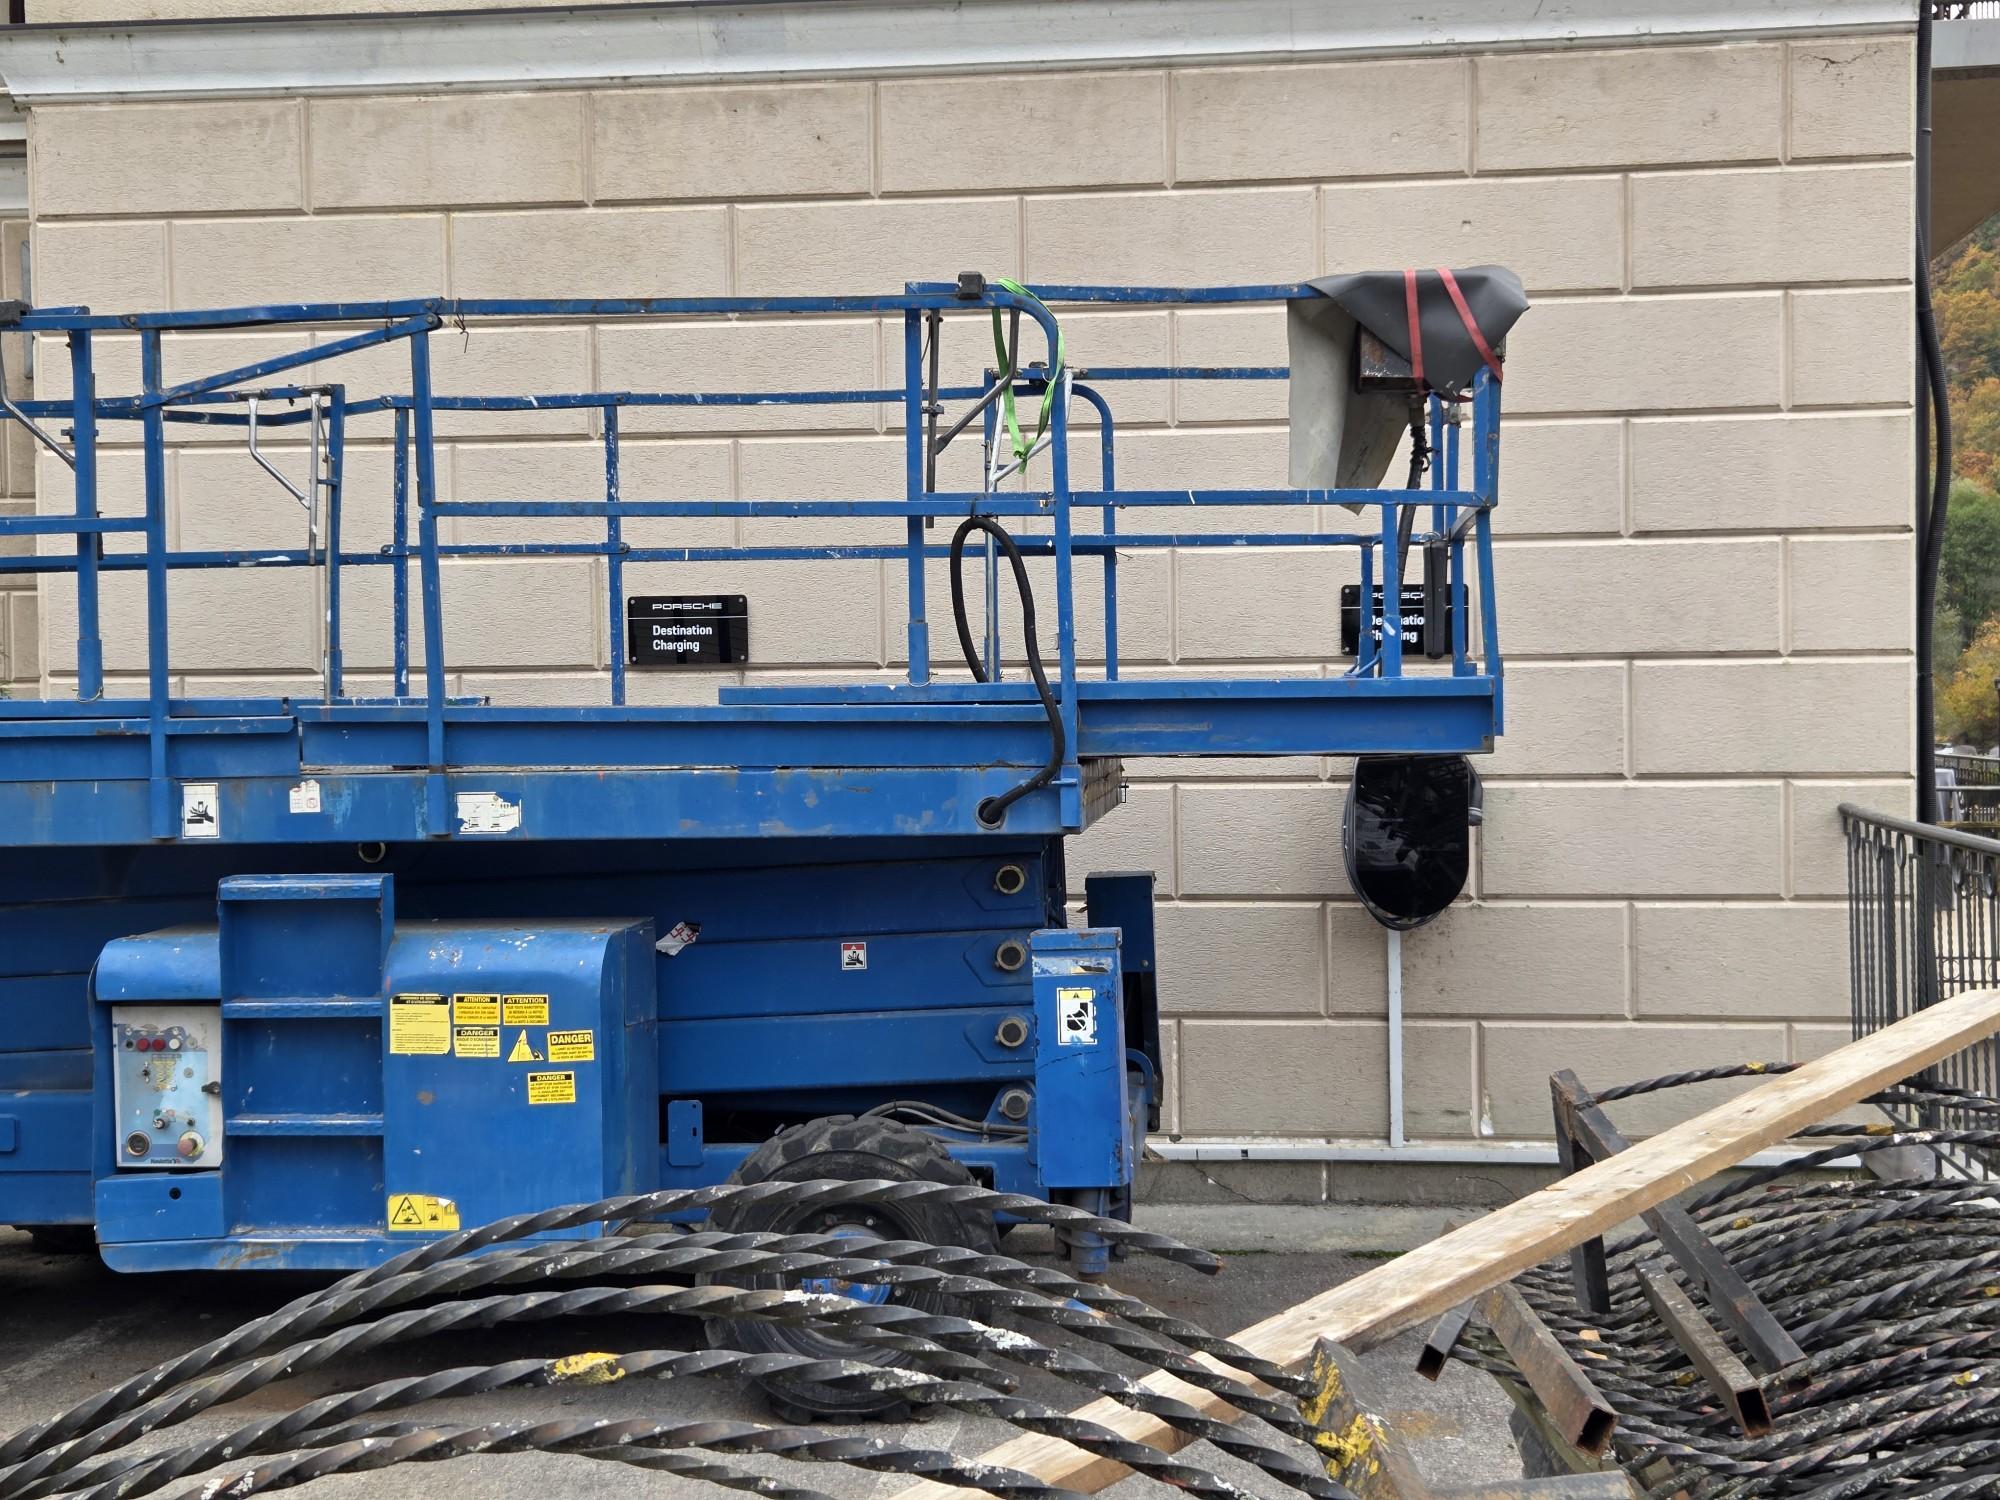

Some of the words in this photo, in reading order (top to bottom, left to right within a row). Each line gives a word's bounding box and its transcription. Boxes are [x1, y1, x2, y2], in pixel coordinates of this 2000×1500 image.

[652, 624, 712, 636] Destination
[652, 640, 700, 652] Charging
[551, 1034, 592, 1044] DANGER
